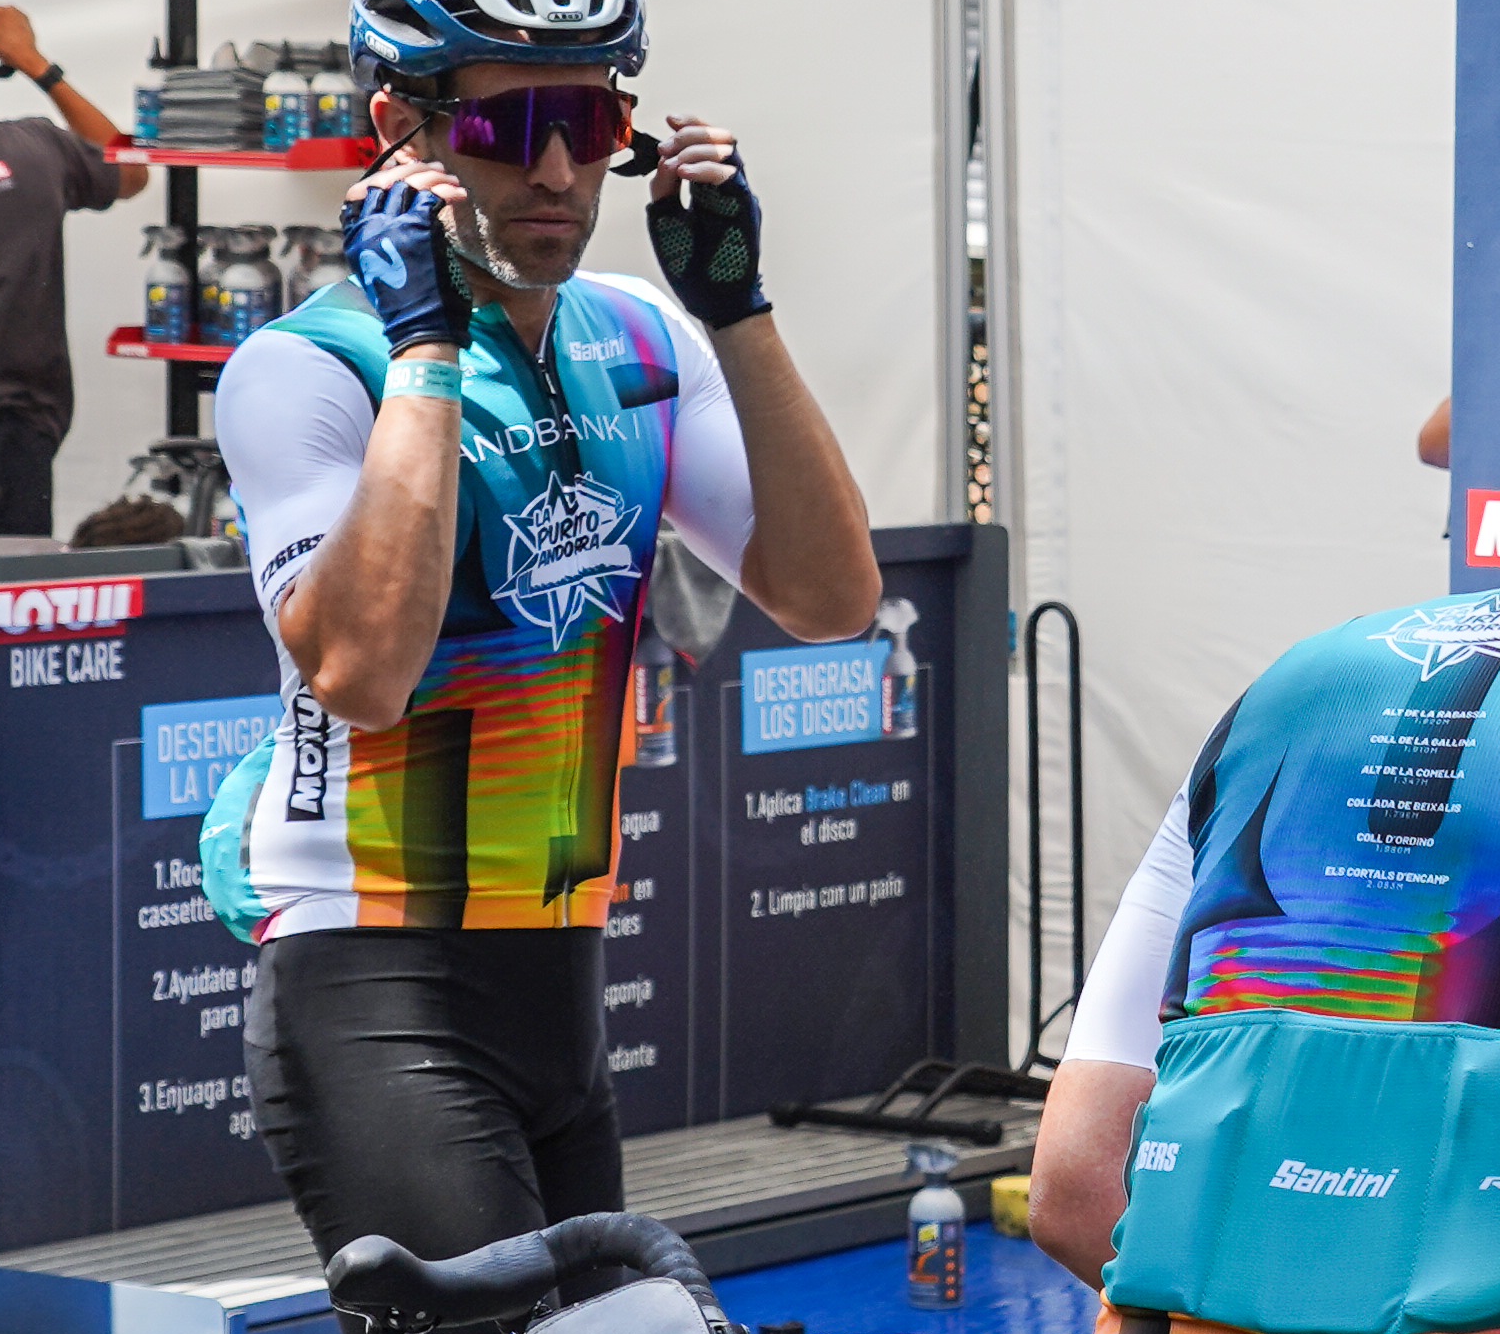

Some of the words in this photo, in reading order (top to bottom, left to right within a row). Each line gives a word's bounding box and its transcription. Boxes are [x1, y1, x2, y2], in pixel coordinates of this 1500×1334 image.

[569, 335, 626, 361] Santini
[459, 413, 627, 465] ANDBANK
[535, 508, 551, 527] LA
[538, 510, 599, 550] PURITO
[10, 645, 65, 688] BIKE
[66, 639, 125, 683] CARE
[754, 659, 875, 703] DESENGRASA
[760, 704, 797, 740] LOS
[802, 696, 870, 736] DISCOS
[1382, 708, 1405, 717] ALT
[1404, 710, 1418, 718] DE
[1419, 710, 1435, 718] LA
[1369, 734, 1397, 745] COLL
[1398, 736, 1414, 746] DE
[1414, 737, 1430, 746] LA
[170, 765, 198, 804] LA
[1361, 765, 1382, 775] ALT
[1383, 766, 1398, 776] DE
[1399, 767, 1414, 777] LA
[1415, 768, 1465, 779] COMELLA
[1346, 798, 1395, 809] COLLADA
[1397, 800, 1412, 810] DE
[1413, 801, 1462, 813] BEIXALIS
[621, 810, 660, 840] agua
[1356, 832, 1383, 844] COLL
[1325, 866, 1345, 877] ELS
[1346, 867, 1394, 881] CORTALS
[1396, 871, 1450, 885] D'ENCAMP
[138, 894, 216, 930] cassette
[604, 974, 653, 1010] sponja
[200, 1005, 242, 1038] para
[1269, 1159, 1399, 1199] Santini
